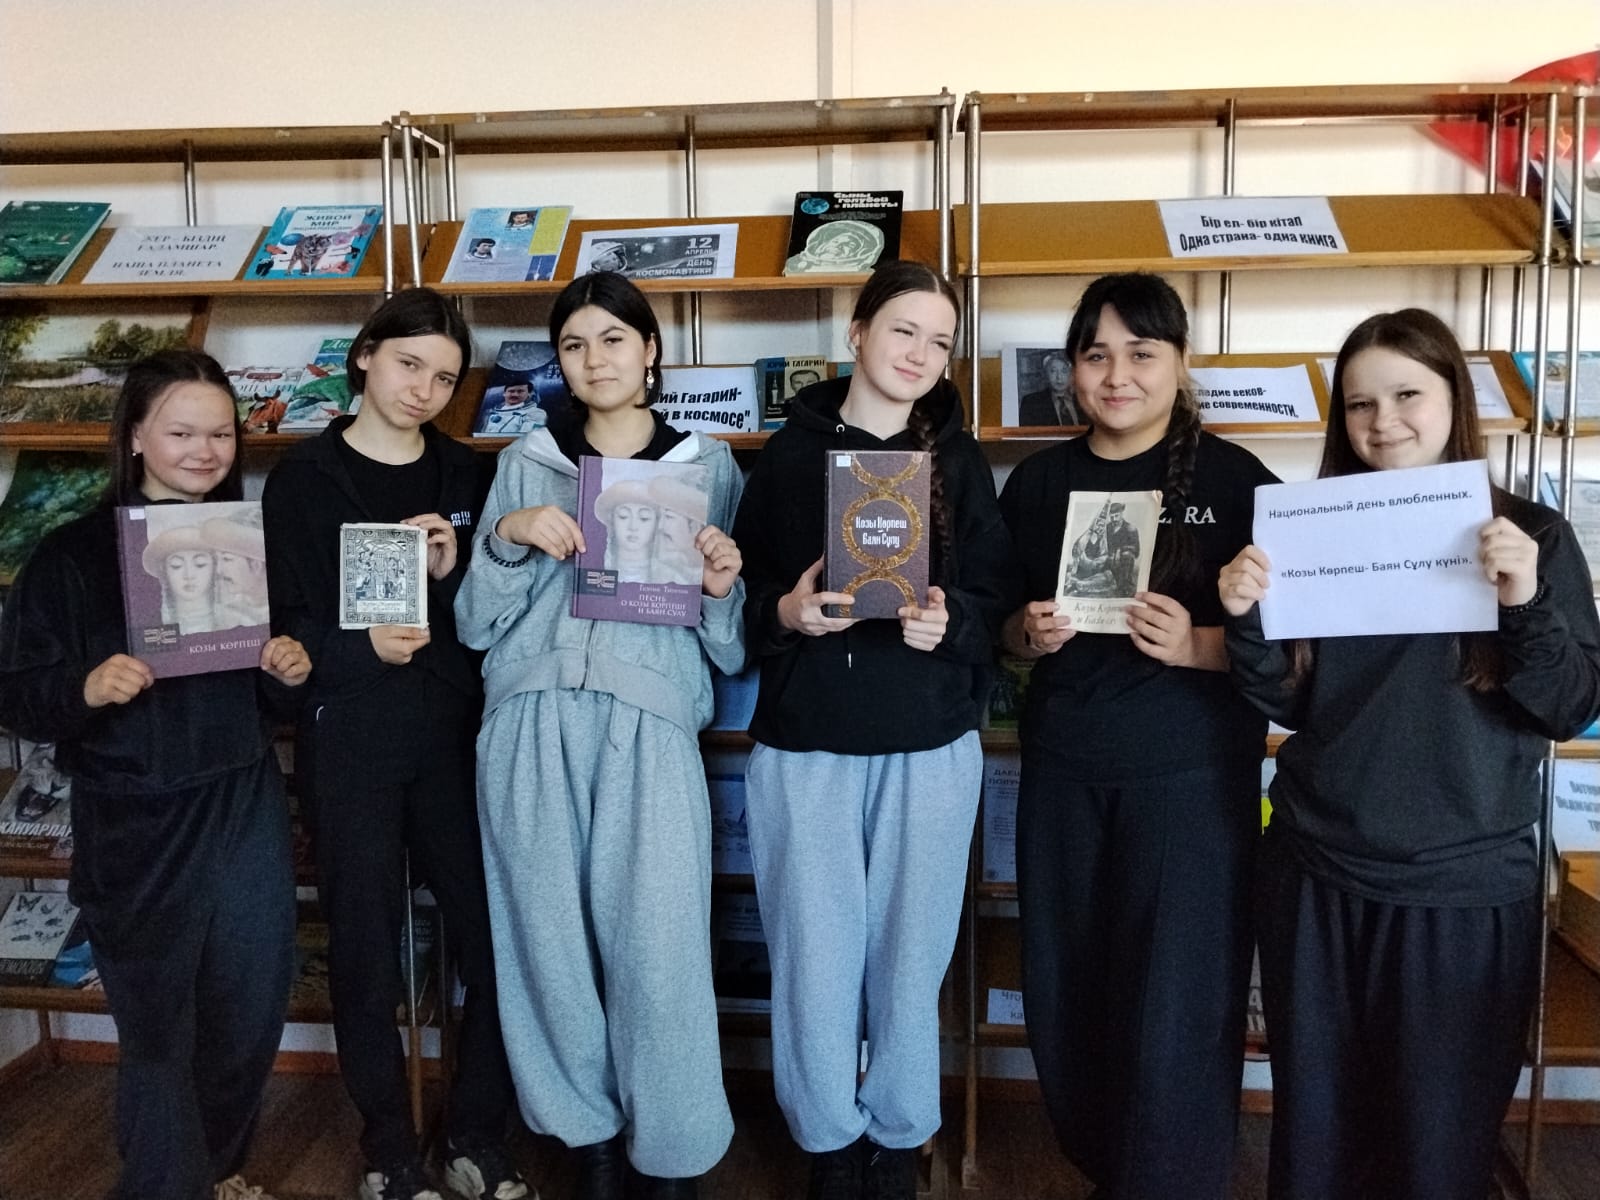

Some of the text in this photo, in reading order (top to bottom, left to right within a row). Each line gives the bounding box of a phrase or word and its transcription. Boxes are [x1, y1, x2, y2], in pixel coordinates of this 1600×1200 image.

[1200, 215, 1222, 229] Бір
[1247, 218, 1268, 228] бір
[1269, 215, 1303, 227] кітап
[687, 237, 713, 249] 12
[1179, 233, 1211, 252] Одна
[1264, 232, 1298, 243] одна
[1300, 233, 1339, 250] книга
[686, 258, 713, 267] ДЕНЬ
[636, 268, 712, 277] КОСМОНАВТИКИ
[792, 359, 825, 368] ГАГАРИН
[656, 391, 679, 404] ий
[672, 410, 681, 420] в
[1268, 501, 1354, 520] Национальный
[1356, 498, 1386, 512] день
[1371, 561, 1401, 572] Баян
[189, 644, 216, 654] КОЗЫ
